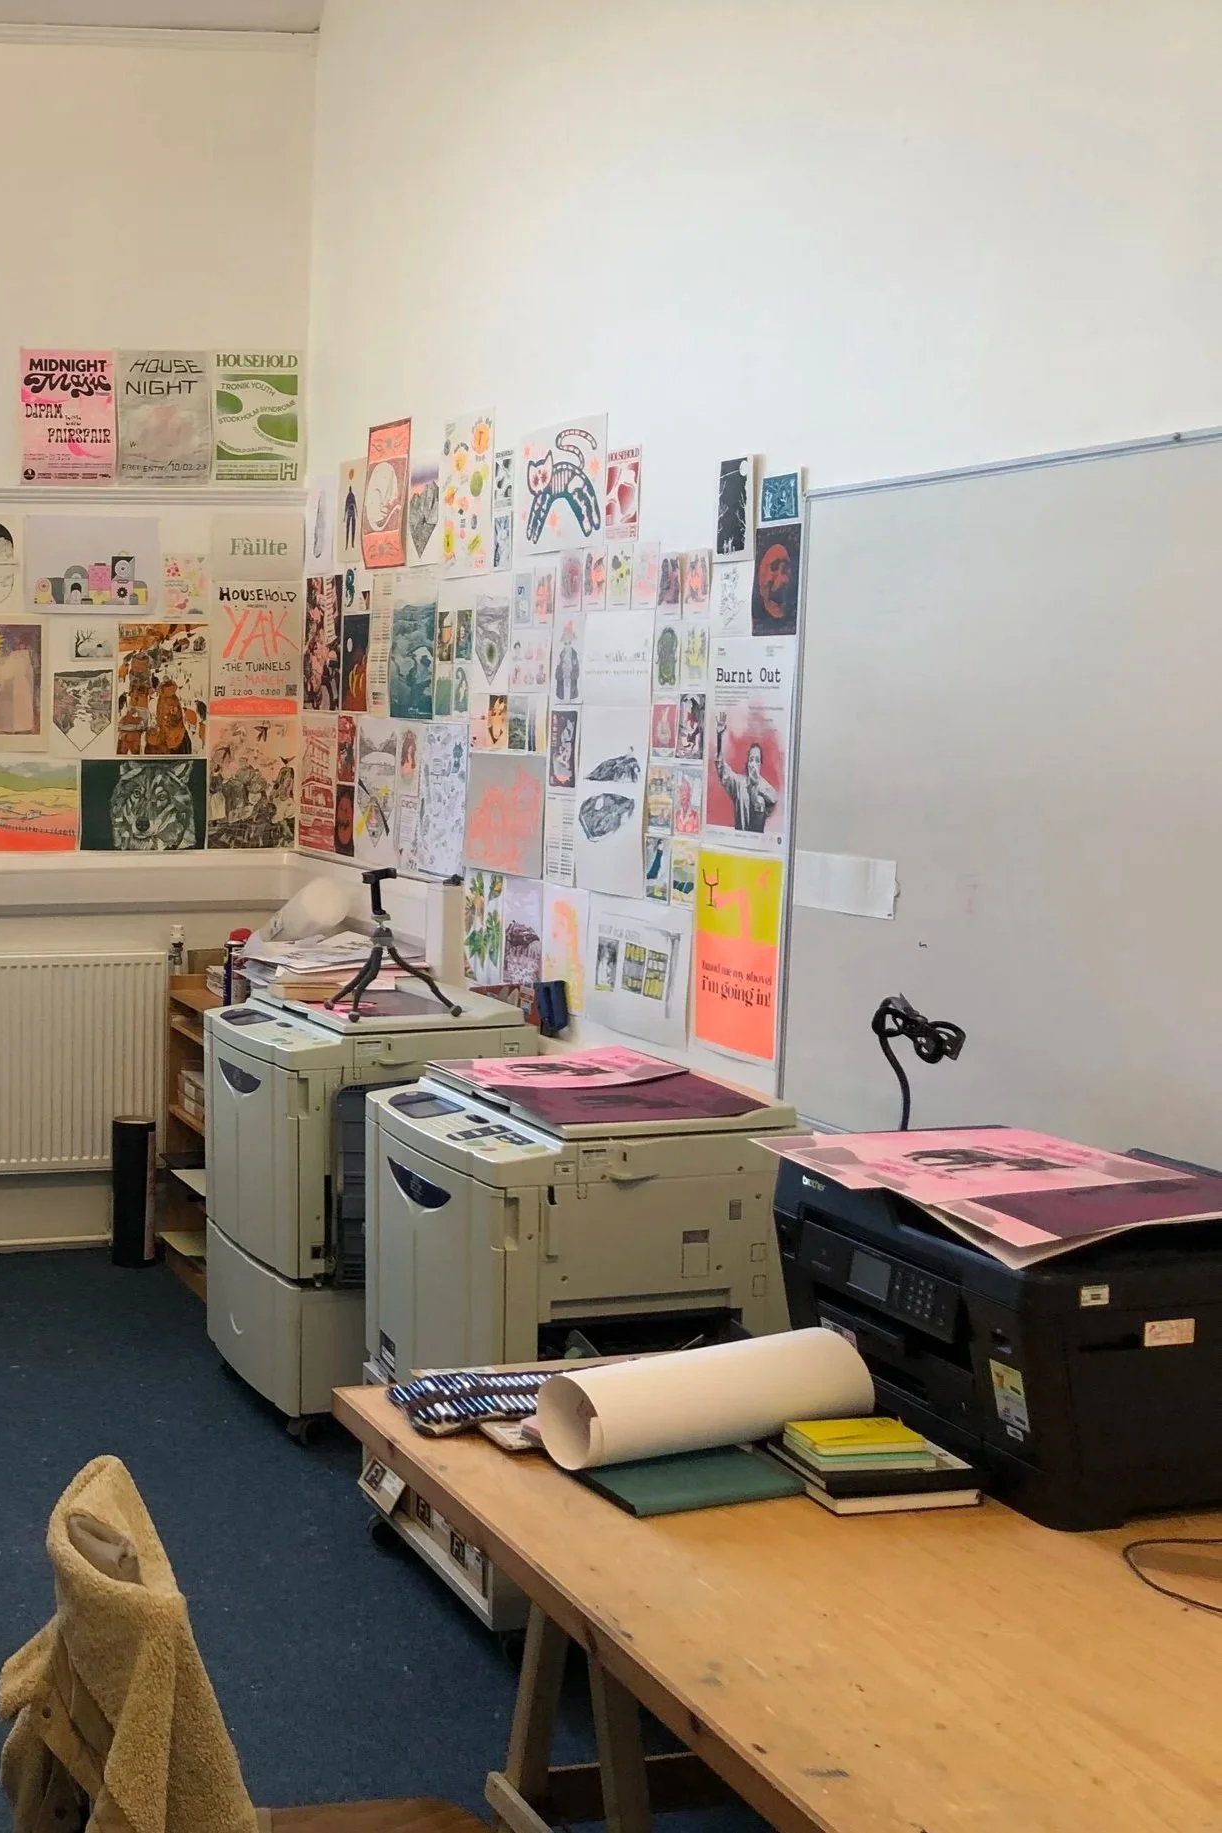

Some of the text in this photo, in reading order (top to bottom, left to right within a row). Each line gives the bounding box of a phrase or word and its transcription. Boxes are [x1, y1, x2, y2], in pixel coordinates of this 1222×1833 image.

[29, 358, 107, 372] MIDNIGHT
[129, 358, 204, 373] HOUSE
[216, 354, 298, 368] HOUSEHOLD
[125, 380, 199, 395] NIGHT
[251, 382, 276, 397] YOUTH
[217, 400, 296, 424] STOCKHOLM SYNDROME
[229, 537, 288, 556] Fàilte
[219, 587, 297, 603] HOUSEHOLD
[222, 605, 300, 660] YAK
[246, 661, 291, 672] TUNNELS
[716, 667, 782, 683] Burnt Out
[745, 971, 773, 986] shovel
[720, 981, 754, 1008] going
[756, 988, 771, 1008] in!
